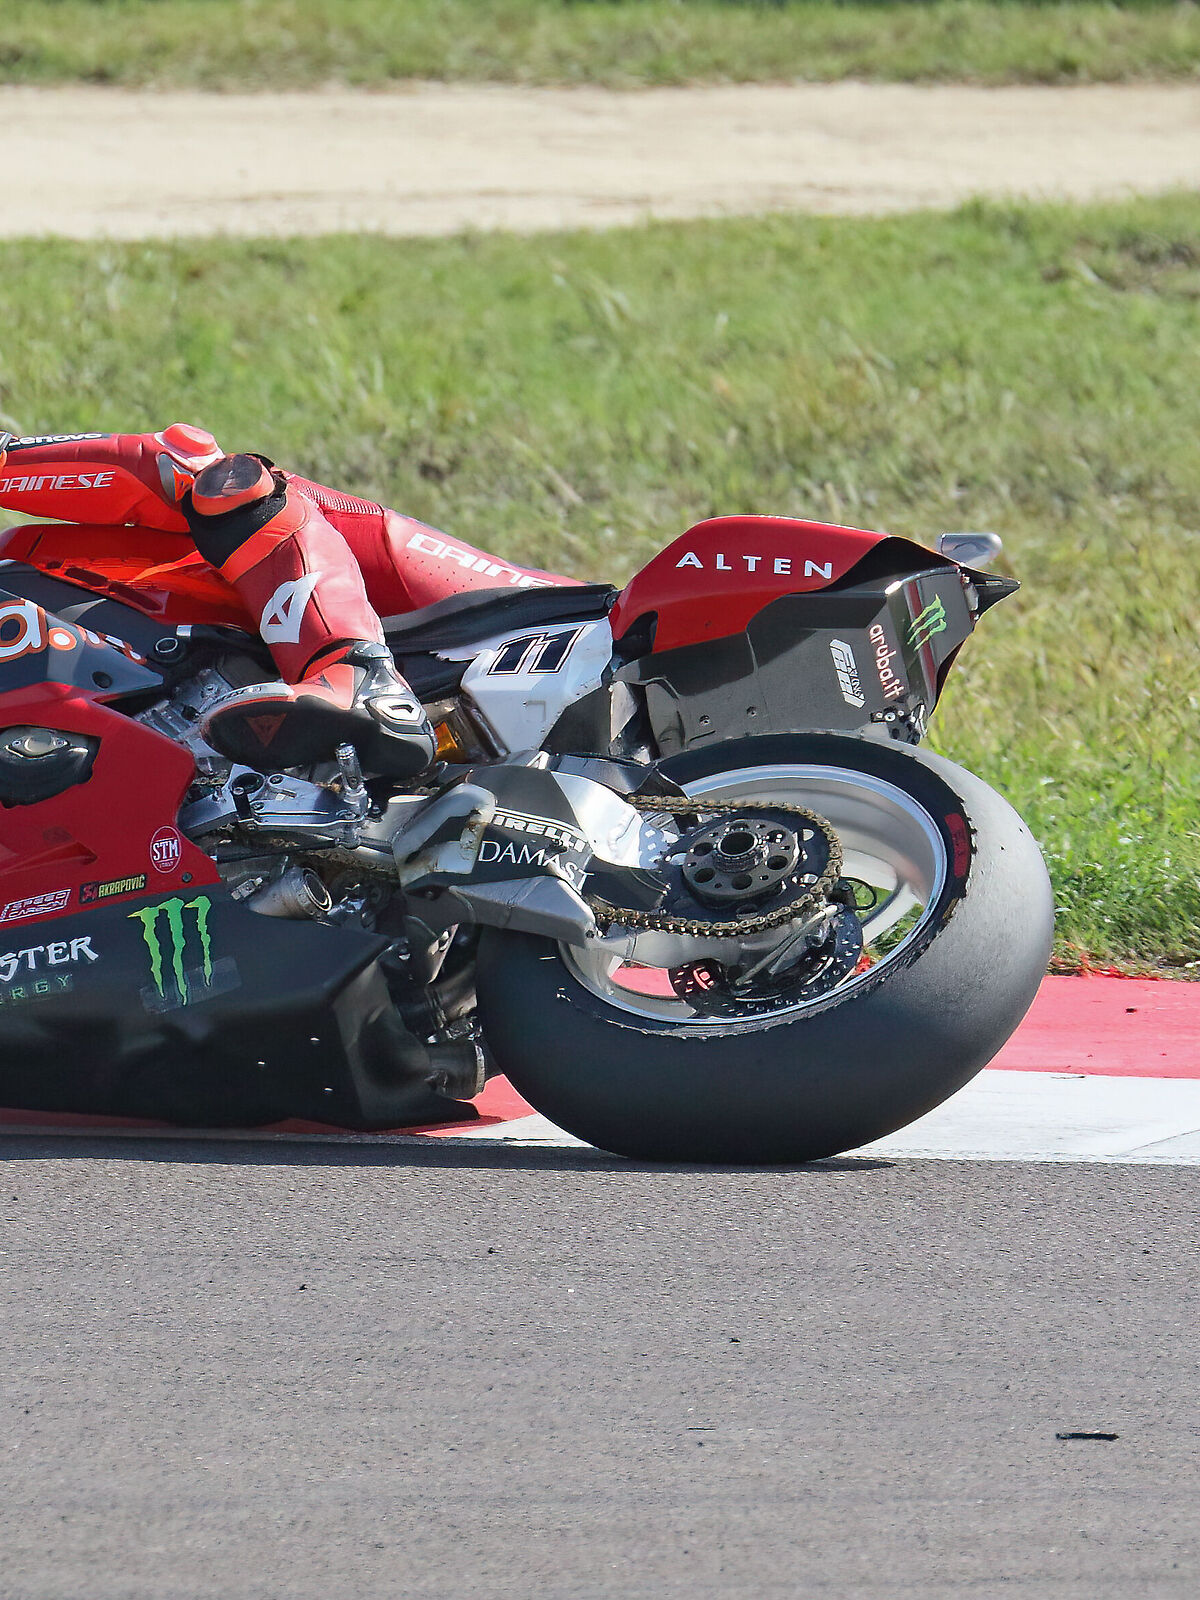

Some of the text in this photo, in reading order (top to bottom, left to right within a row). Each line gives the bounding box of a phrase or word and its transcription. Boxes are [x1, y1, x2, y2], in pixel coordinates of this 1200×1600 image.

[676, 552, 833, 579] ALTEN
[487, 626, 585, 675] 11
[869, 624, 905, 699] aruba.it
[152, 840, 179, 861] STM
[493, 814, 587, 853] IRELLI
[478, 840, 596, 893] DAMAST
